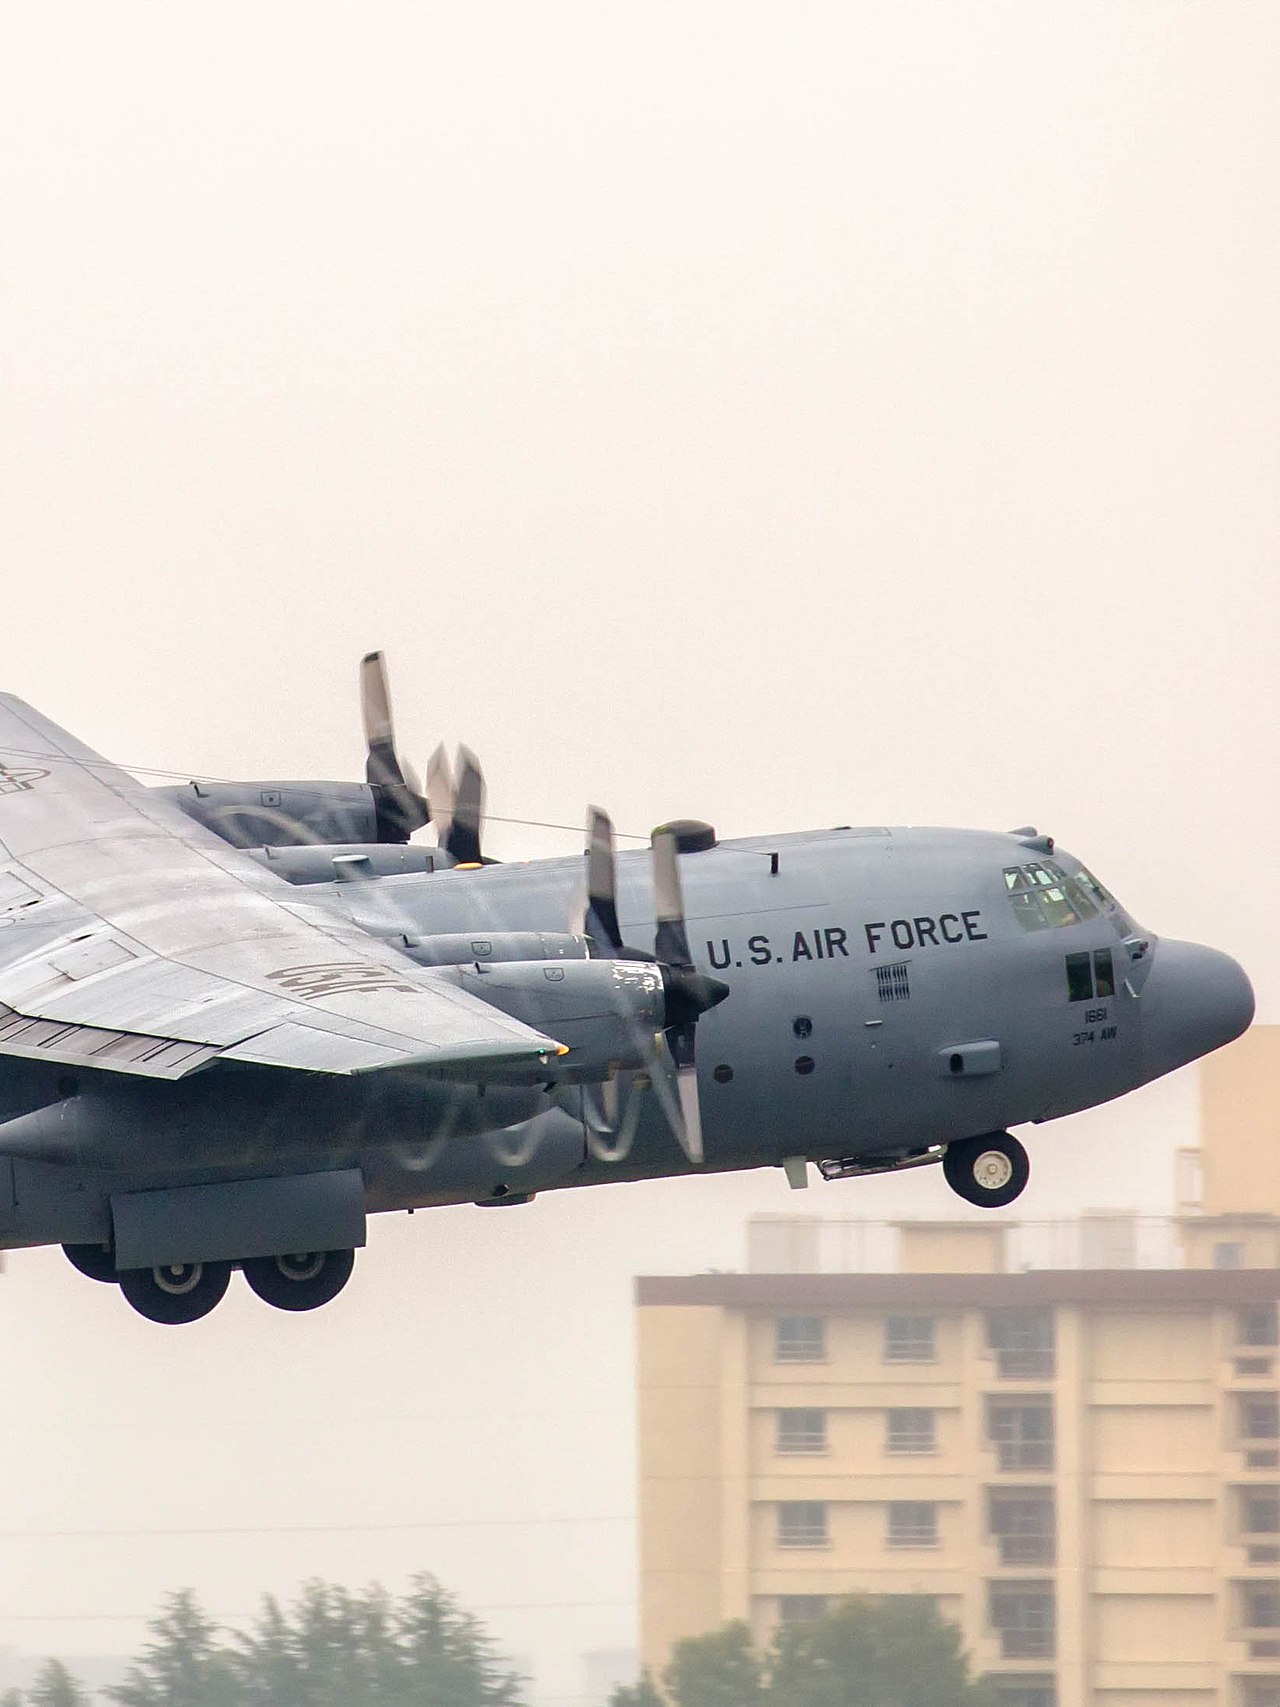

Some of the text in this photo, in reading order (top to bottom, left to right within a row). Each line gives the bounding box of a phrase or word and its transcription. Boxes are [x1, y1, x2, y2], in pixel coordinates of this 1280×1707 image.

[792, 927, 850, 962] AIR
[864, 910, 988, 953] FORCE
[264, 962, 421, 1001] USAF
[1072, 1026, 1118, 1046] 374 AW
